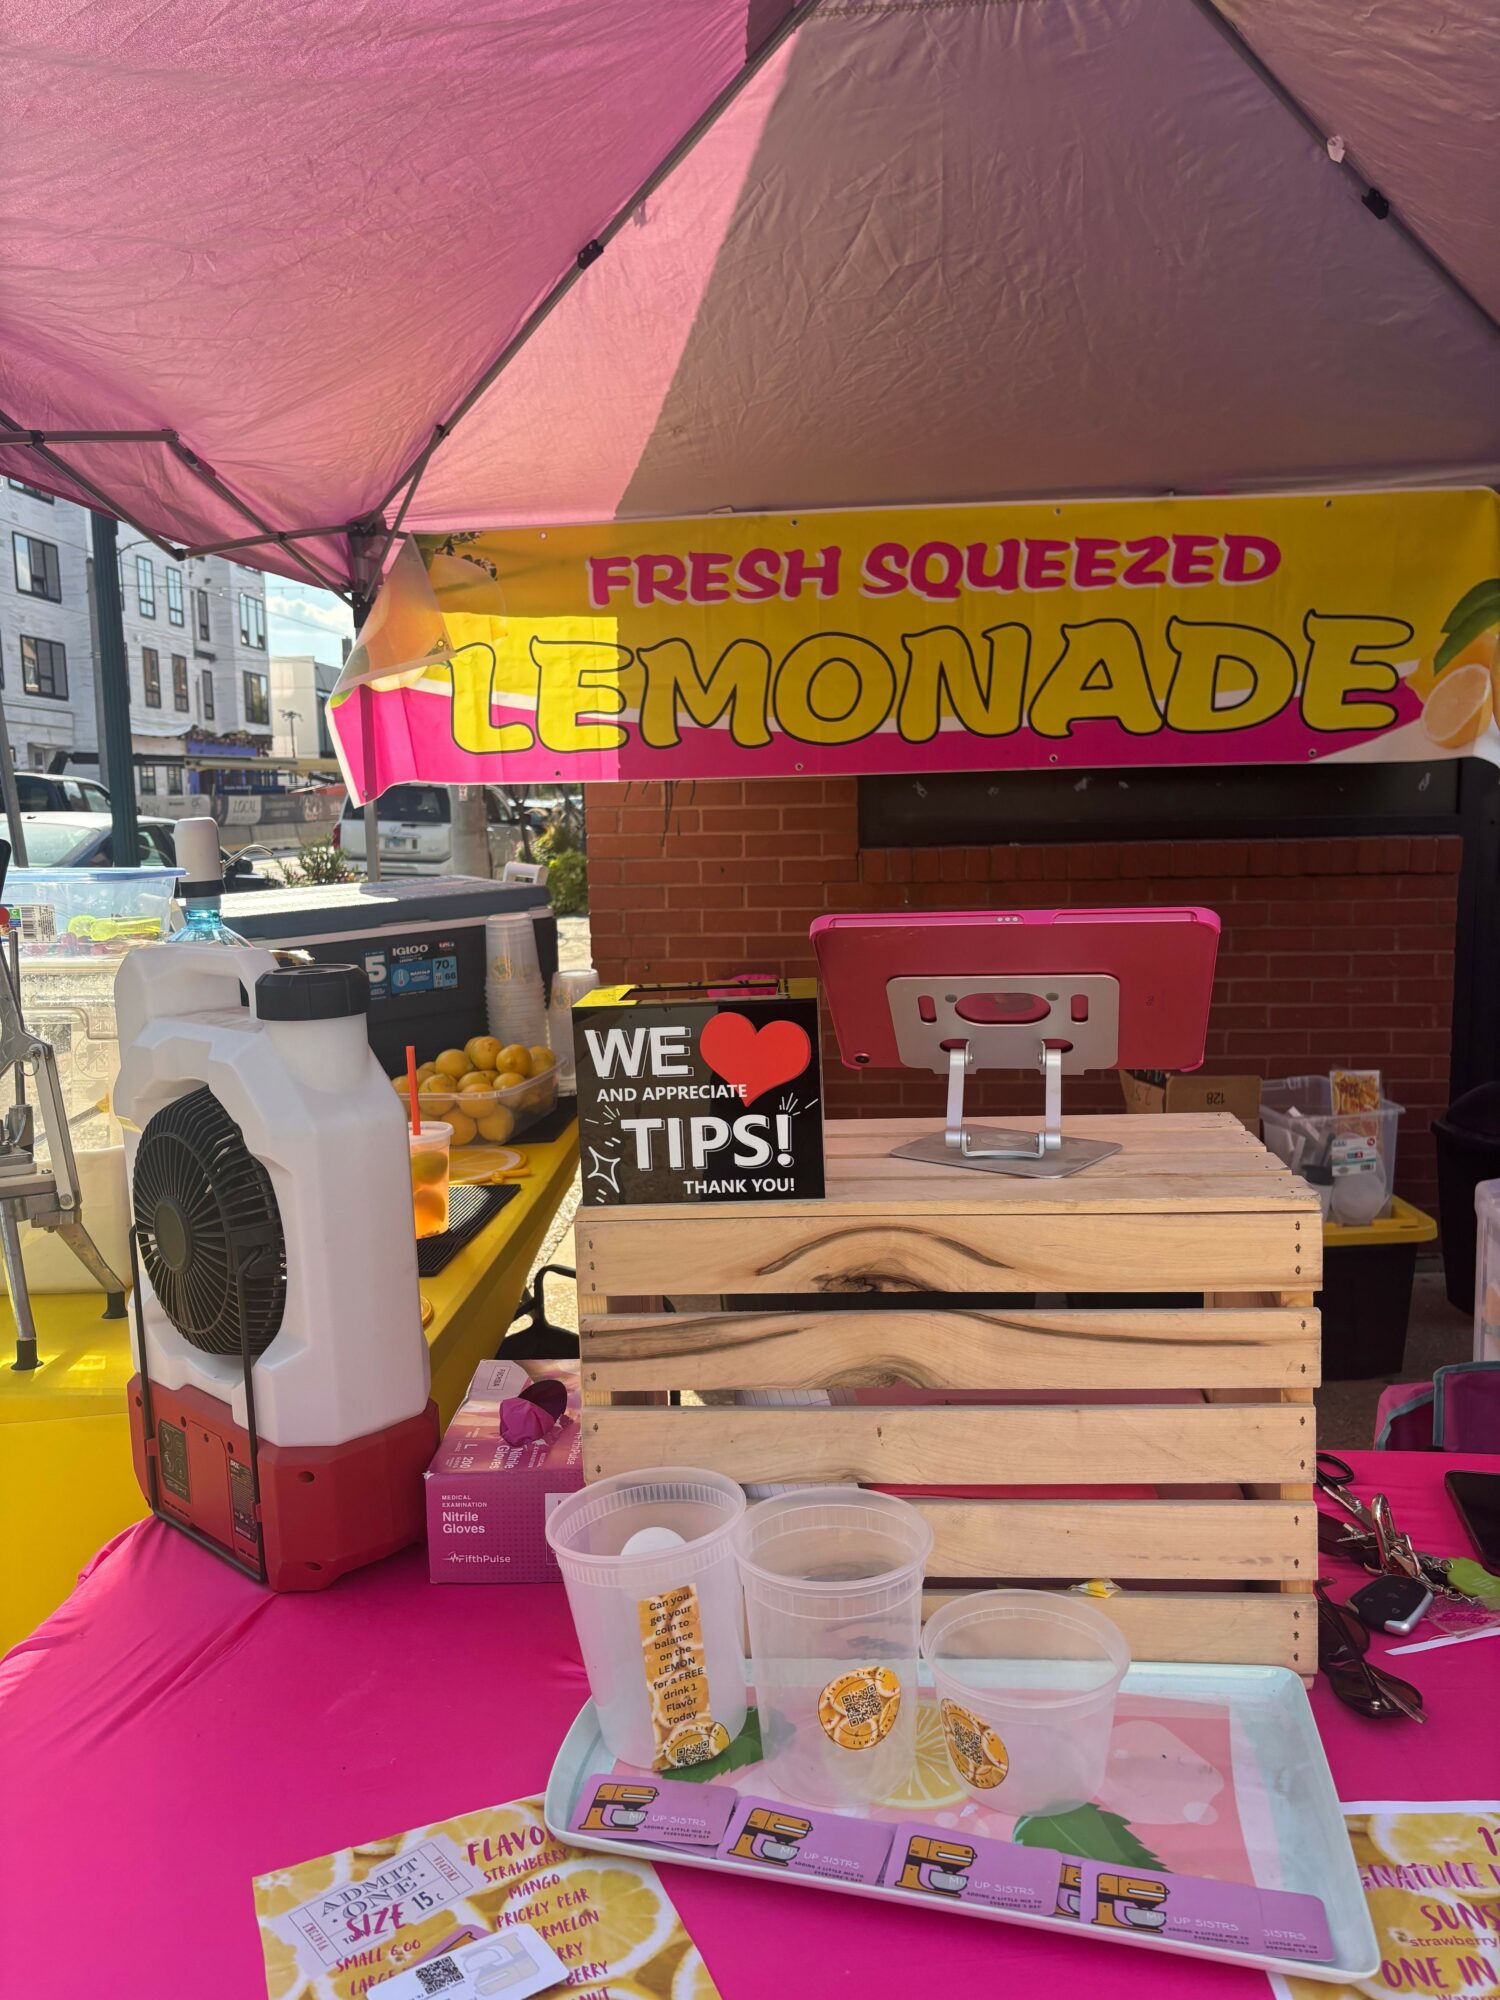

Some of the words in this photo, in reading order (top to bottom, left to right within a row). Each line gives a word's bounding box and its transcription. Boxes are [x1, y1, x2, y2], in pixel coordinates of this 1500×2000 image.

[587, 546, 843, 607] FRESH
[861, 533, 1281, 600] SQUEEZED
[450, 609, 1415, 753] LEMONADE
[392, 944, 429, 957] IGLOO
[365, 954, 387, 983] 5
[435, 960, 450, 970] 70
[584, 1026, 694, 1079] WE
[597, 1088, 638, 1102] AND
[642, 1084, 748, 1101] APPRECIATE
[620, 1114, 795, 1171] TIPS!
[684, 1179, 748, 1195] THANK
[751, 1178, 795, 1193] YOU!
[442, 1511, 479, 1522] Nitrile
[442, 1523, 486, 1534] Gloves
[457, 1554, 511, 1563] FifthPulse
[649, 1600, 668, 1611] Can
[670, 1593, 690, 1606] you
[650, 1614, 666, 1627] get
[668, 1605, 692, 1619] your
[655, 1624, 677, 1636] coin
[679, 1620, 690, 1628] to
[654, 1632, 694, 1650] balance
[660, 1652, 673, 1661] on
[674, 1646, 692, 1656] the
[658, 1657, 696, 1675] LEMON
[653, 1680, 668, 1690] for
[679, 1666, 704, 1681] FREE
[664, 1686, 689, 1700] drink
[691, 1683, 698, 1691] 1
[666, 1697, 698, 1713] Flavor
[666, 1711, 697, 1726] Today
[670, 1816, 707, 1827] SISTRS
[467, 1825, 557, 1866] FLAVO
[1477, 1827, 1500, 1856] 1
[483, 1849, 569, 1883] STRAWBERRY
[803, 1852, 819, 1860] UP
[821, 1856, 860, 1870] SISTRS
[321, 1857, 418, 1918] ADMIT
[508, 1873, 561, 1899] MANGO
[974, 1881, 991, 1889] UP
[993, 1884, 1035, 1895] SISTRS
[342, 1876, 418, 1920] ONE
[411, 1891, 434, 1911] 15
[495, 1901, 550, 1928] PRICKLY
[556, 1888, 590, 1908] PEAR
[346, 1902, 406, 1941] SIZE
[1173, 1916, 1191, 1925] UP
[1195, 1919, 1239, 1931] SISTRS
[1409, 1935, 1498, 1949] strawberry
[336, 1948, 382, 1973] SMALL
[1381, 1956, 1450, 1988] ONE
[1456, 1955, 1499, 1987] IN
